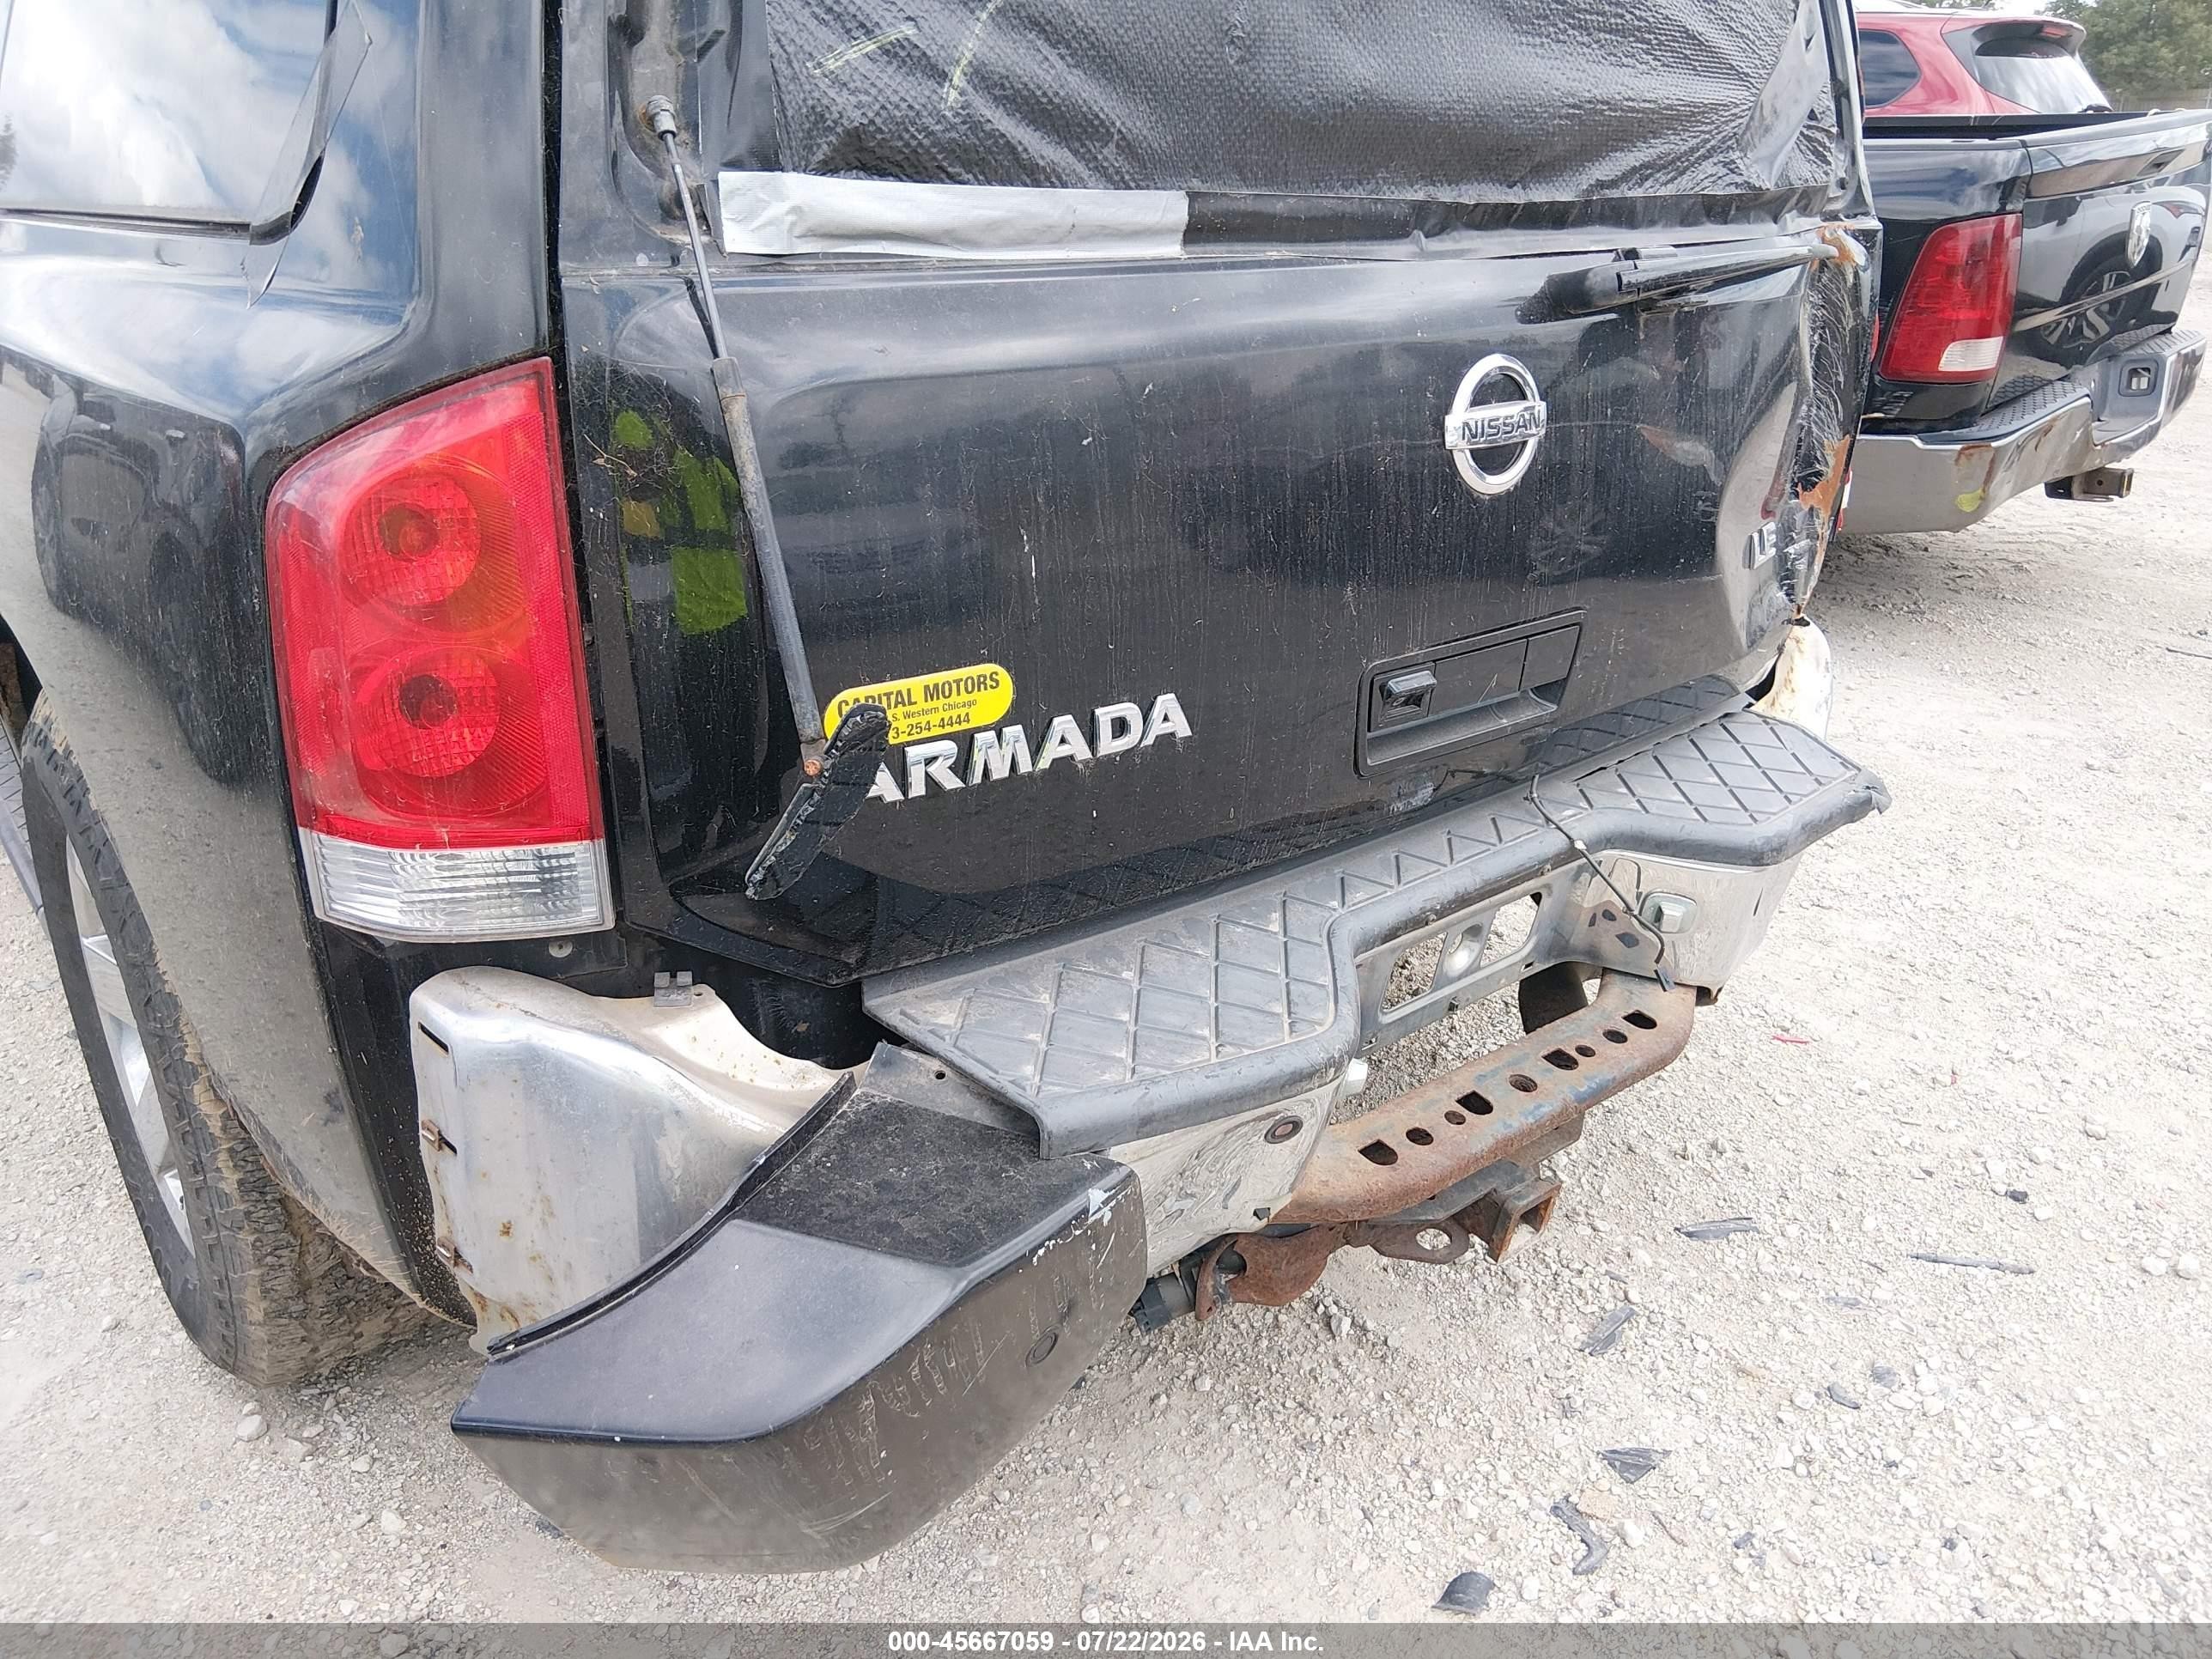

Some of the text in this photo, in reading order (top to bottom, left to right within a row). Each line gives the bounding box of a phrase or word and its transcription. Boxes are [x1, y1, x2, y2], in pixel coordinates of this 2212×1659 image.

[1462, 410, 1541, 442] NISSAN
[924, 671, 1000, 702] MOTORS
[891, 699, 977, 722] S. Western Chicago
[865, 692, 1193, 804] ARMADA
